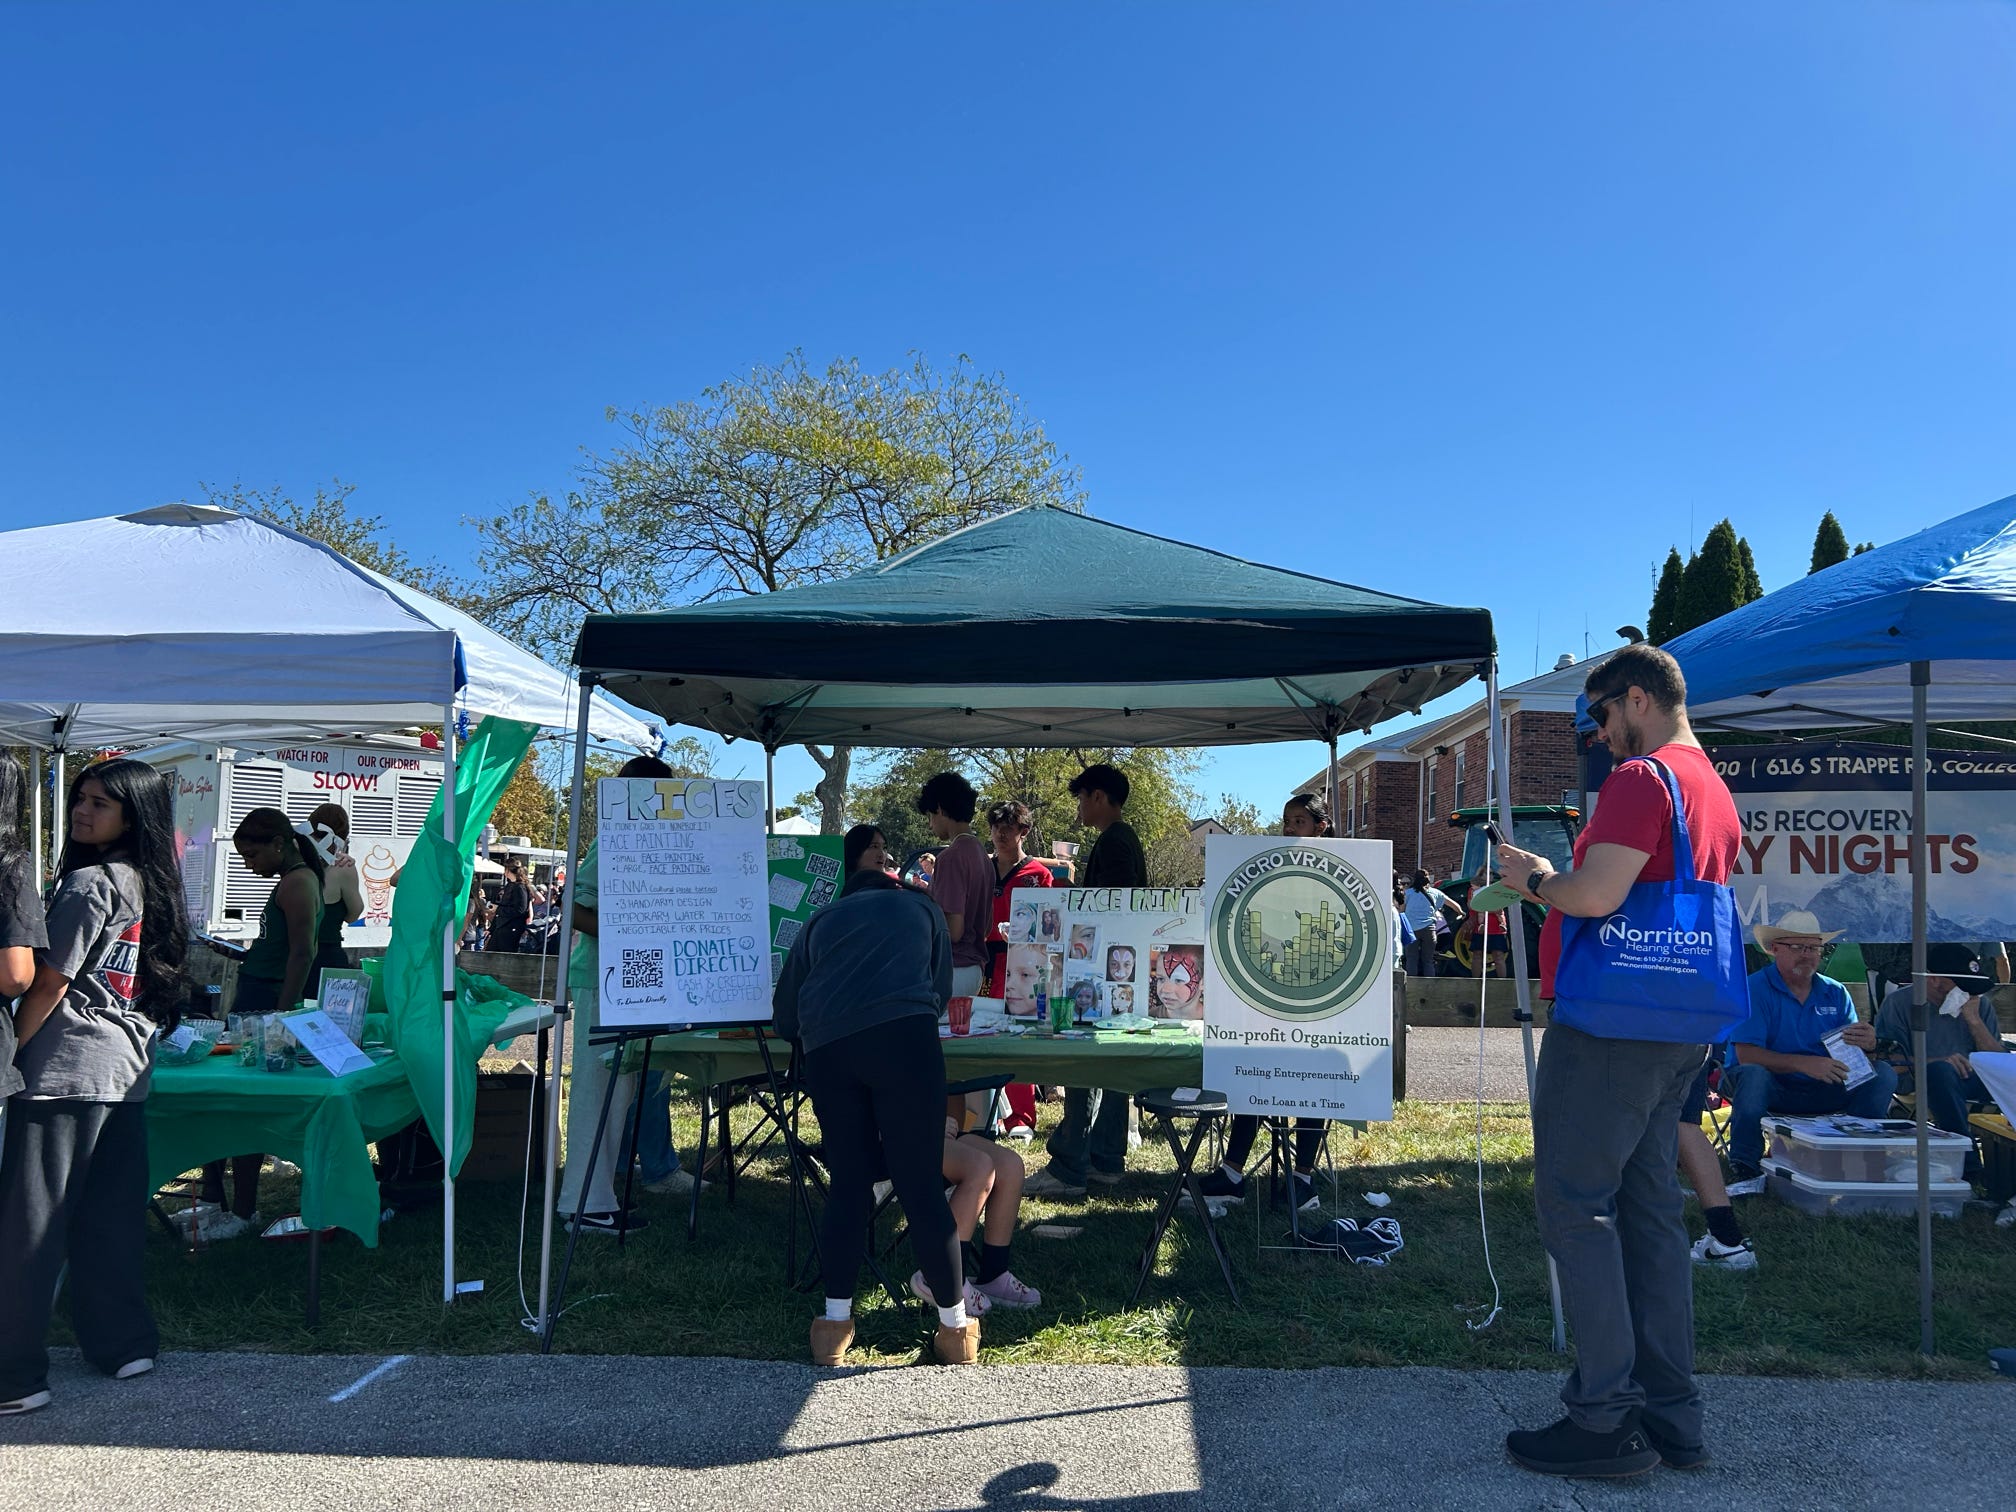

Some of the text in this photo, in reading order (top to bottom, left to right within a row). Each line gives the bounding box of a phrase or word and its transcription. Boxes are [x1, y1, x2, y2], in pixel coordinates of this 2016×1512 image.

[276, 750, 420, 770] WATCH FOR OUR CHILDREN
[1766, 758, 1805, 775] 616
[1810, 757, 1821, 774] S
[1826, 757, 1900, 774] TRAPPE
[313, 771, 378, 792] SLOW!
[601, 779, 760, 820] PRICES
[602, 822, 611, 830] ALL
[615, 822, 637, 830] MONEY
[640, 822, 655, 830] GOES
[658, 822, 666, 830] TO
[1774, 809, 1912, 832] RECOVERY
[600, 832, 695, 850] FACE PAINTING
[615, 855, 636, 863] SMALL
[641, 853, 661, 863] FACE
[664, 853, 705, 862] PAINTING
[1789, 834, 1979, 875] NIGHTS
[650, 865, 668, 874] FACE
[672, 864, 712, 873] PAINTING
[603, 879, 648, 893] HENNA
[1226, 850, 1375, 912] MICRO VRA FUND
[628, 898, 674, 908] HAND/ARM
[677, 898, 713, 907] DESIGN
[1068, 888, 1200, 914] FACE PAINT
[603, 911, 752, 924] TEMPORARY WATER TATTOOS
[622, 924, 732, 936] NEGOTIABLE FOR PRICES
[1605, 921, 1713, 946] Norriton
[673, 938, 739, 957] DONATE
[1626, 940, 1712, 956] Hearing Center
[674, 954, 760, 976] DIRECTLY
[1611, 960, 1698, 974] www.norritonhearing.com
[1620, 953, 1689, 965] Phone: 610-277-3336
[678, 974, 761, 991] CASH & CREDIT
[704, 987, 763, 1004] ACCEPTED
[1206, 1025, 1390, 1048] Non-profit Organization
[1235, 1066, 1360, 1084] Fueling Entrepreneurship
[1249, 1095, 1346, 1109] One Loan at a Time
